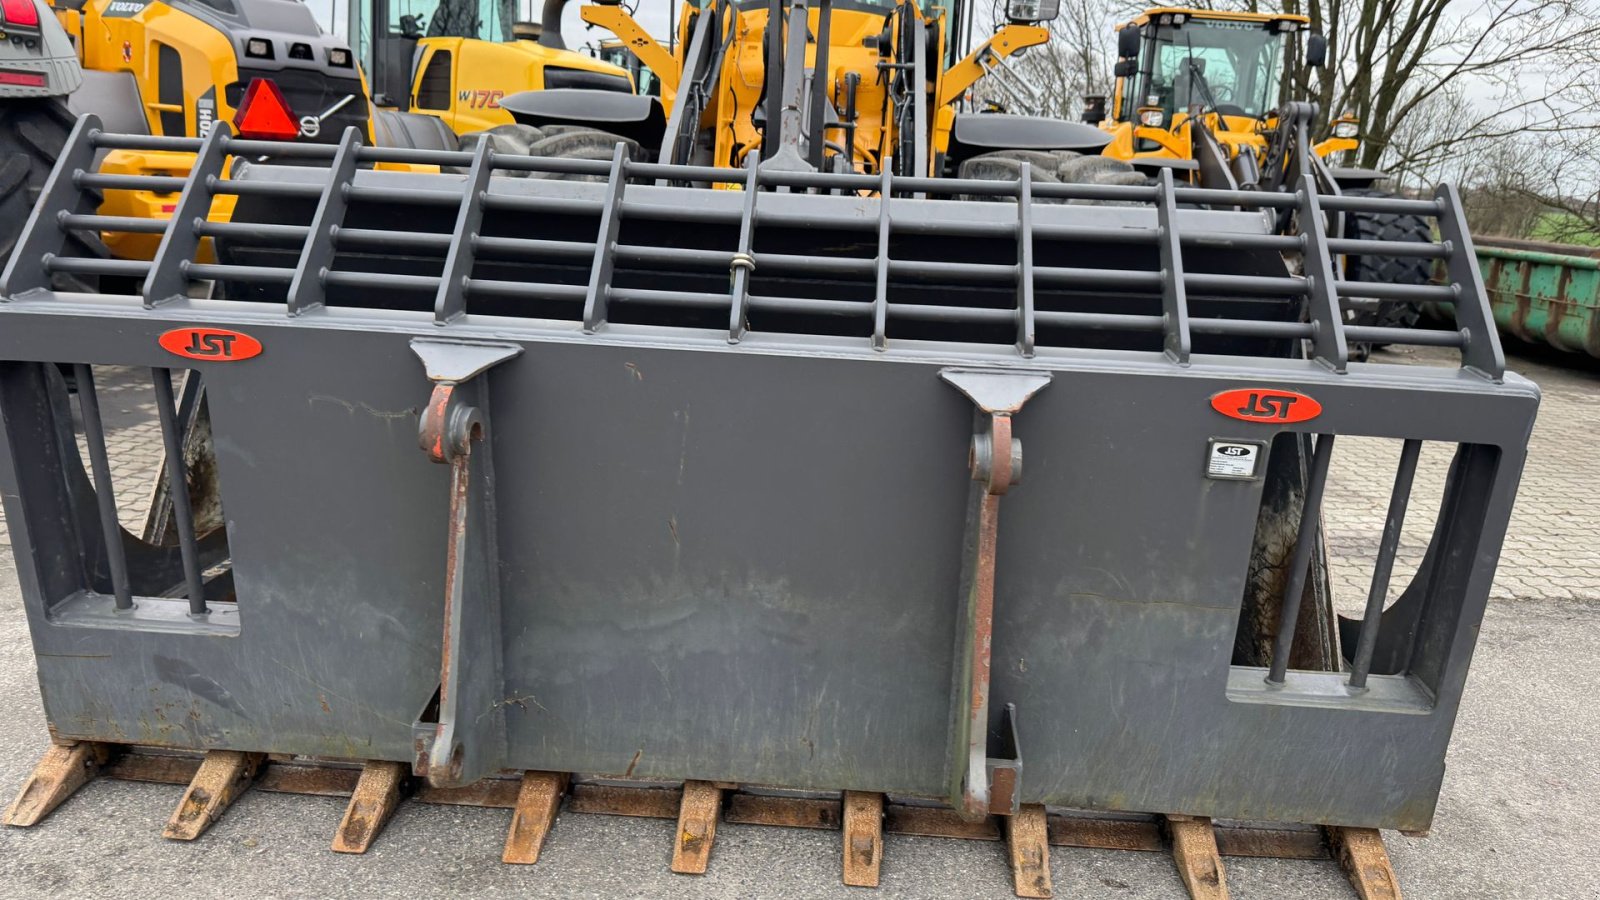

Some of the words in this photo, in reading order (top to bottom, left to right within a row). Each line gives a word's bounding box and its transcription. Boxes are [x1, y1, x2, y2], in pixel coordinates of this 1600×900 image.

[110, 1, 145, 12] VOLVO
[1205, 20, 1254, 31] VOLVO
[184, 332, 236, 356] JST
[1237, 393, 1297, 418] JST
[1224, 447, 1244, 456] JST
